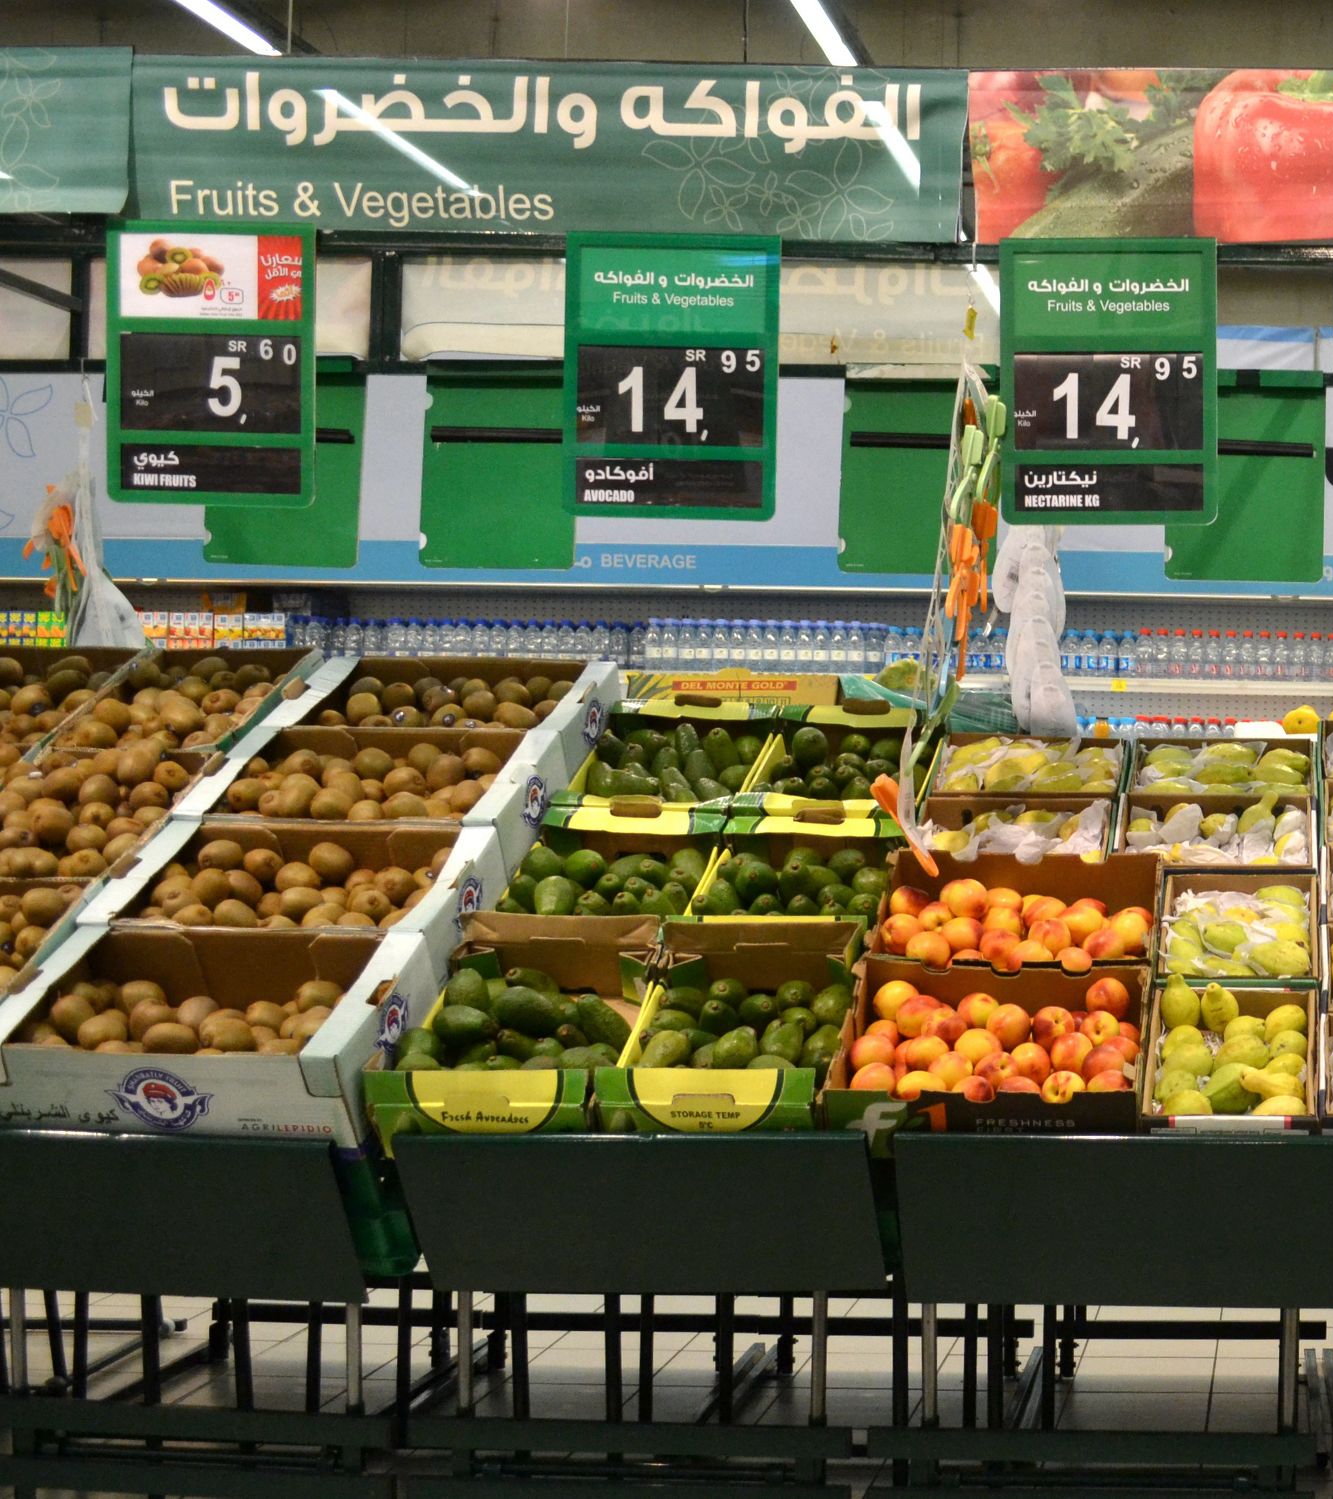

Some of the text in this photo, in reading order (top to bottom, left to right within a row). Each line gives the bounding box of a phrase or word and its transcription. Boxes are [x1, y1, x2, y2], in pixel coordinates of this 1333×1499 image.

[164, 71, 921, 154] الفواكه والخضروات
[169, 180, 554, 227] Fruits & Vegetables
[595, 270, 753, 289] الخضروات و الفواكه
[1028, 277, 1189, 294] الخضروات و الفواكه
[613, 292, 734, 308] Fruits & Vegetables
[1047, 300, 1170, 314] Fruits & Vegetables
[228, 341, 247, 352] SR
[685, 350, 706, 362] SR
[1121, 357, 1141, 368] SR
[134, 451, 179, 469] كيوي
[585, 463, 653, 482] أفوكادو
[1024, 471, 1097, 488] نيكتارين
[133, 473, 197, 487] KIWI FRUITS
[584, 490, 634, 502] AVOCADO
[1024, 494, 1100, 507] NECTARINE KG
[601, 554, 696, 568] BEVERAGE
[681, 682, 702, 690] DEL
[976, 1118, 1076, 1128] FRESHNESS
